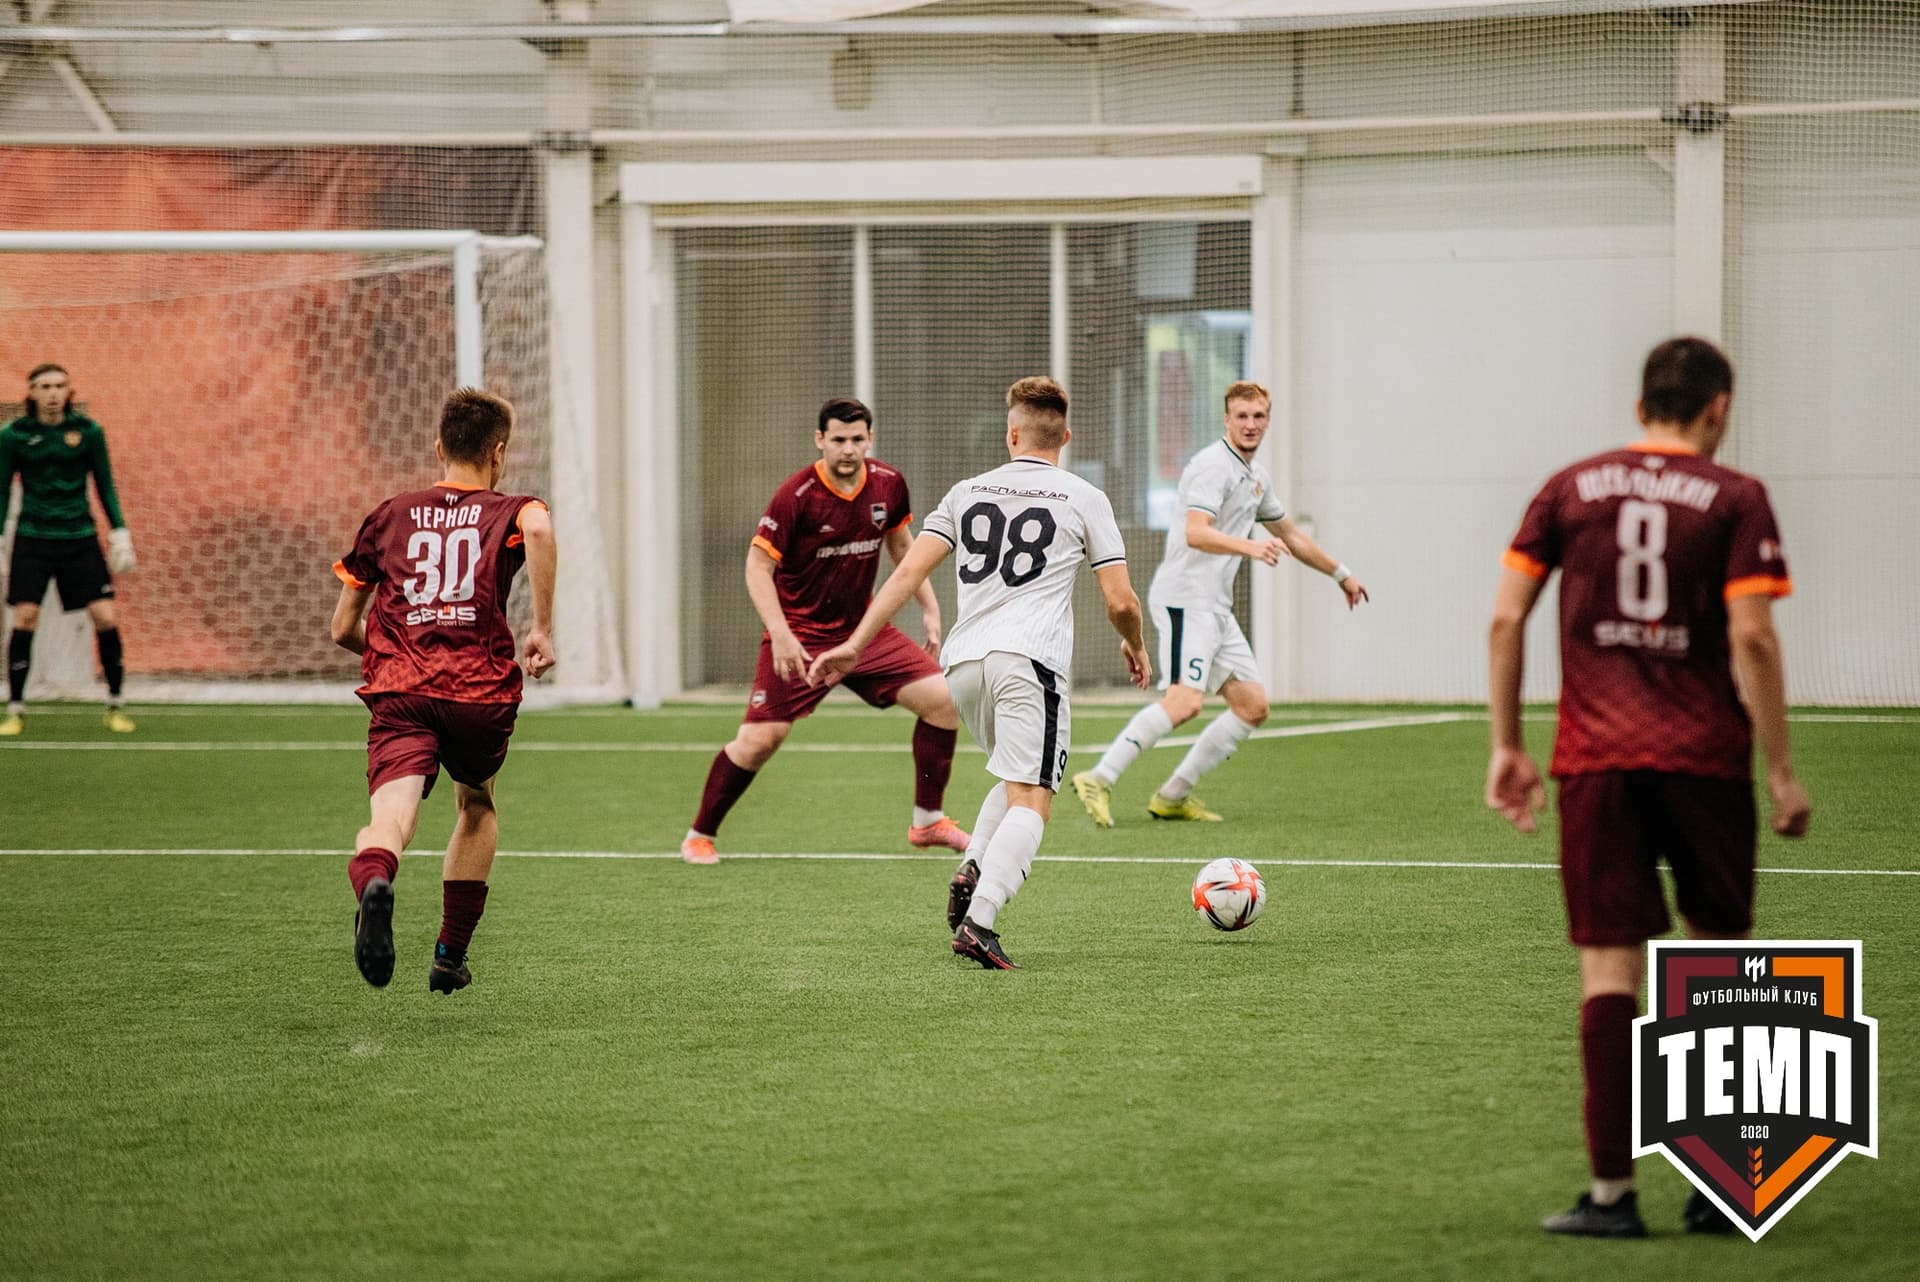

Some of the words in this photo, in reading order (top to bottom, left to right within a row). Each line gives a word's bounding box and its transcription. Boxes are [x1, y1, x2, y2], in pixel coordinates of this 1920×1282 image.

[410, 504, 483, 529] ЧЕРНОВ
[403, 528, 482, 606] 30
[959, 502, 1057, 588] 98
[1617, 499, 1669, 621] 8
[406, 605, 477, 626] SEUS
[1188, 657, 1204, 682] 5
